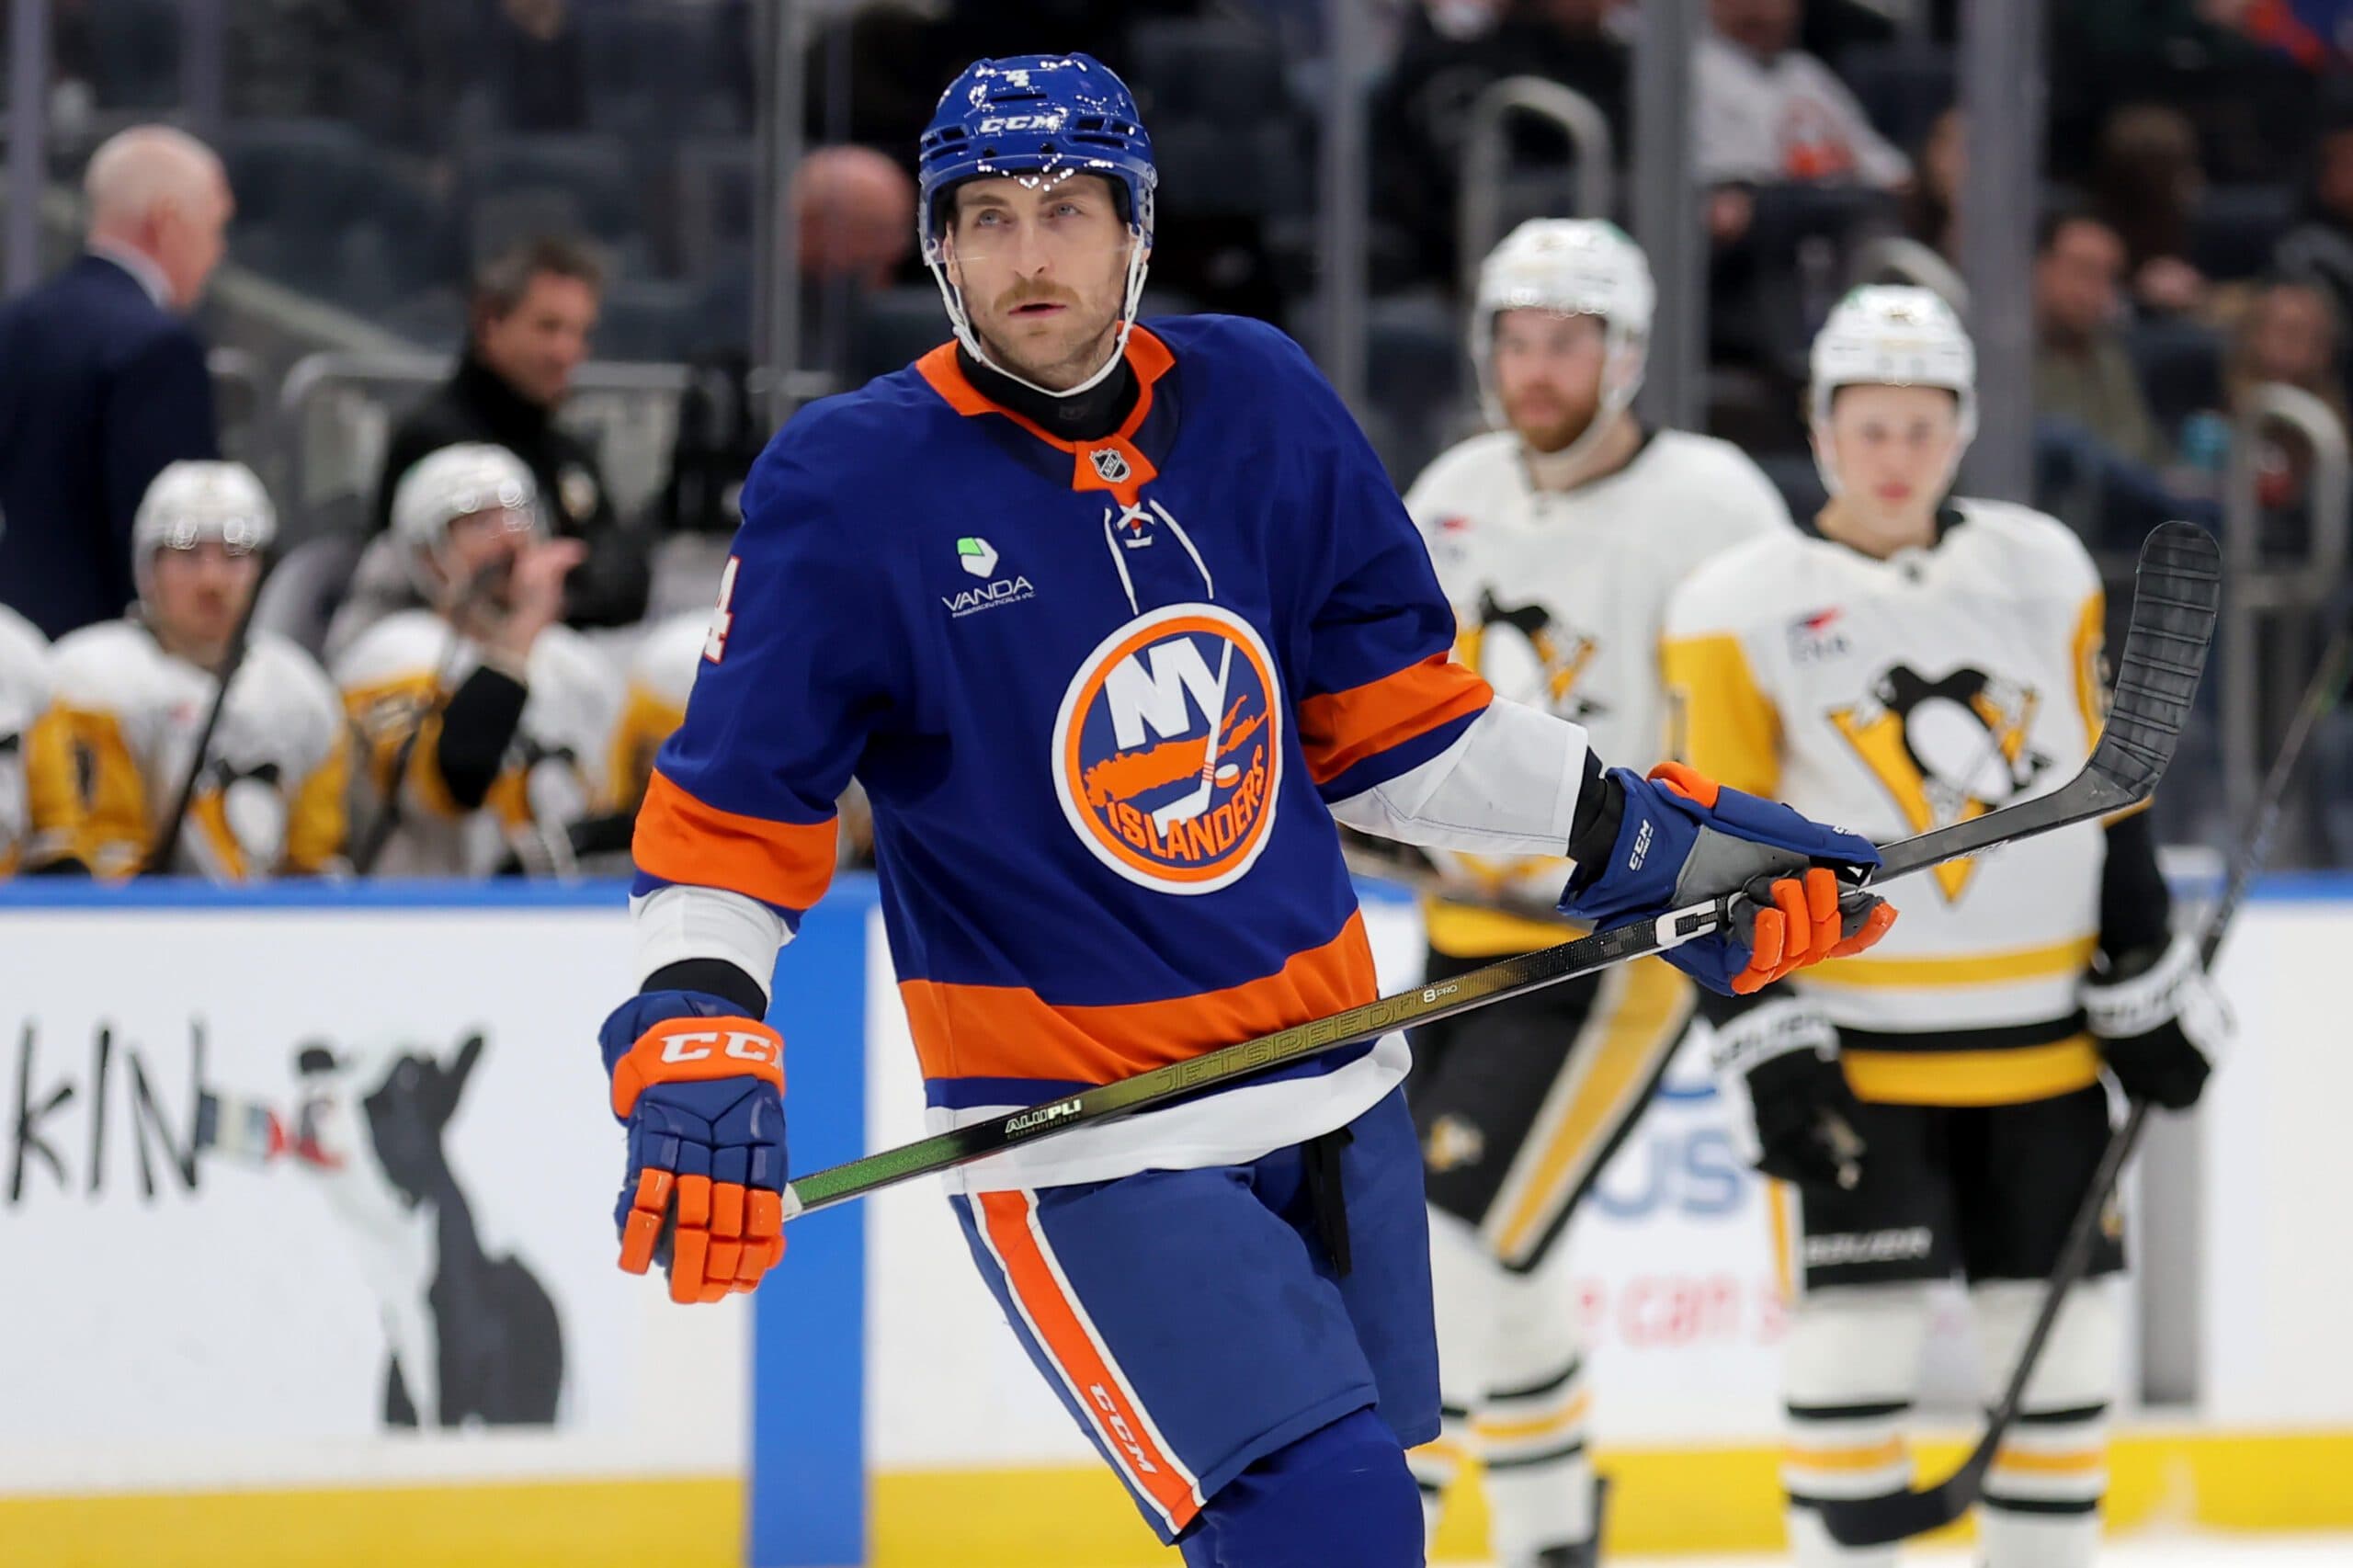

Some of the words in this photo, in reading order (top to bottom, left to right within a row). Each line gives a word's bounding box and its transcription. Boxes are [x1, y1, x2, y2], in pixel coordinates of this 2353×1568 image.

[979, 115, 1062, 133] CCM
[941, 575, 1033, 611] VANDA
[1104, 636, 1234, 751] NY
[1104, 744, 1265, 862] ISLANDERS
[1629, 819, 1651, 871] CCM
[1155, 1001, 1396, 1093] JETSPEED
[1423, 988, 1438, 1005] 8
[1437, 983, 1459, 997] PRO
[1004, 1098, 1082, 1134] ALUPLI
[1088, 1381, 1159, 1473] CCM
